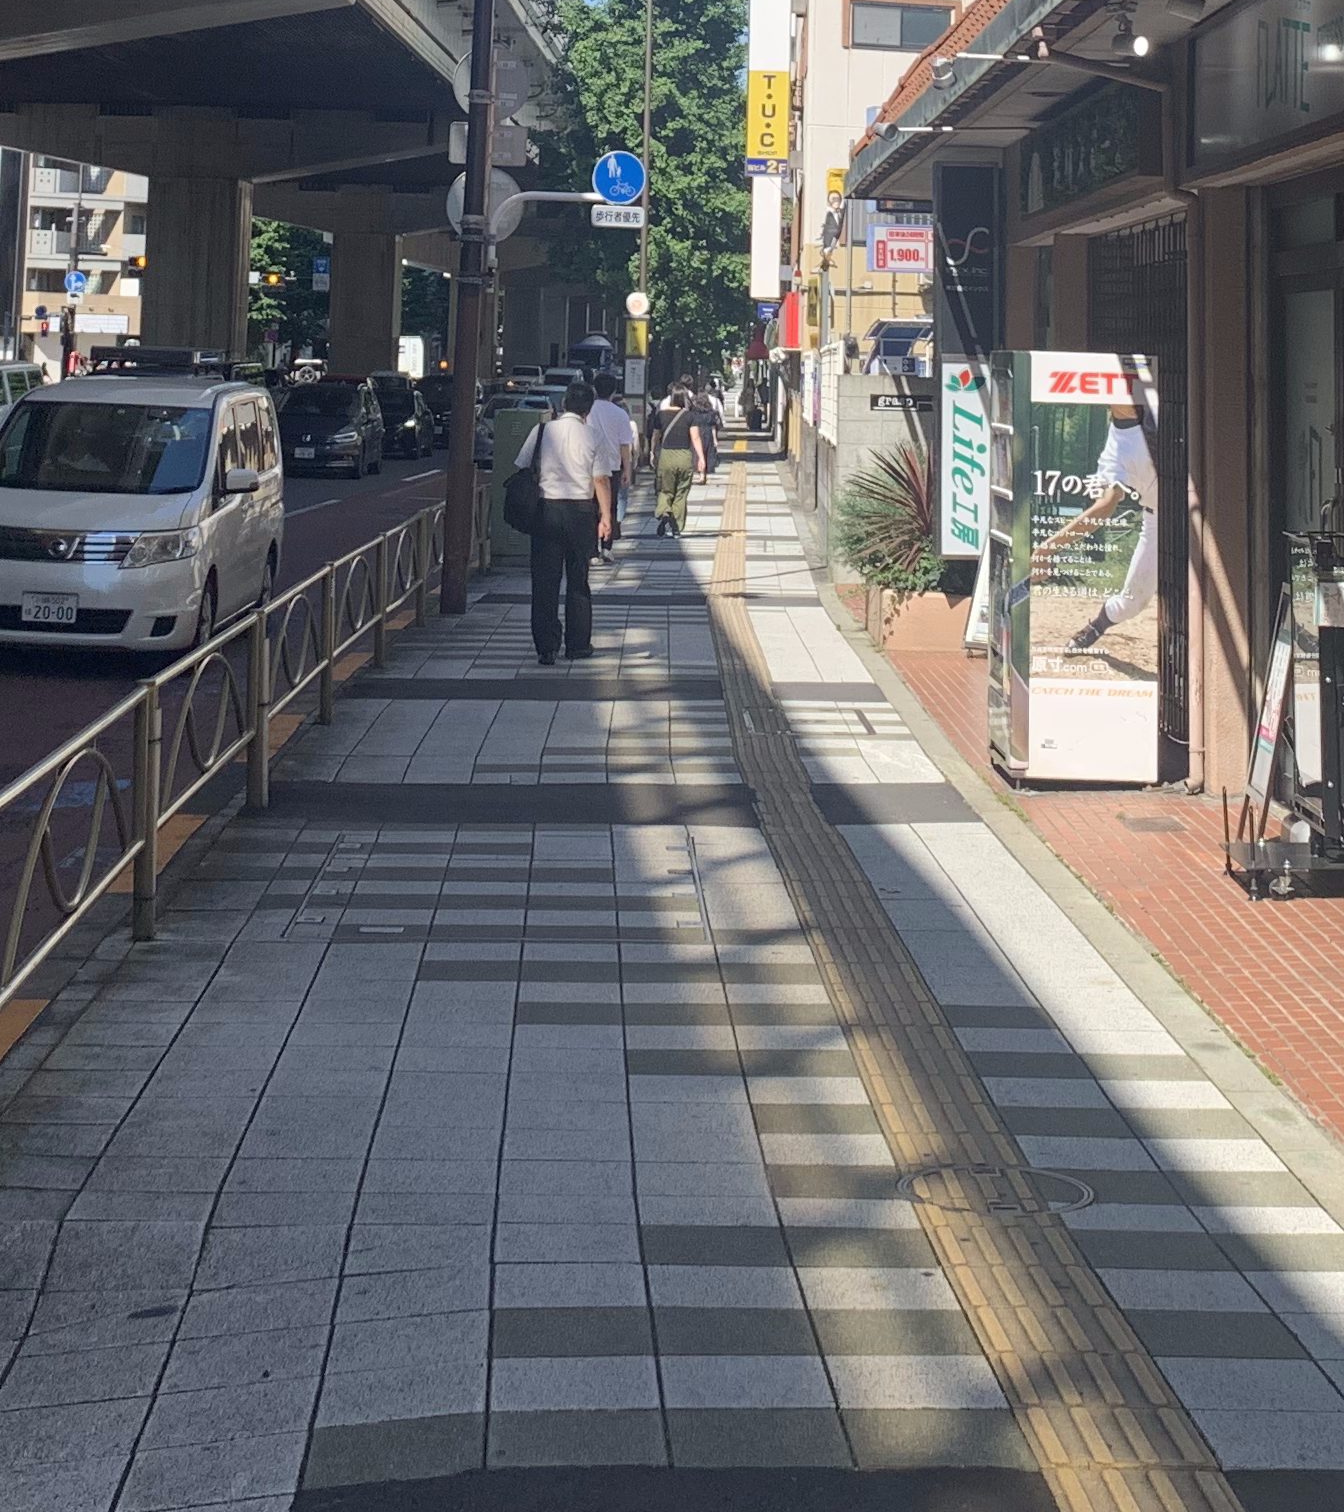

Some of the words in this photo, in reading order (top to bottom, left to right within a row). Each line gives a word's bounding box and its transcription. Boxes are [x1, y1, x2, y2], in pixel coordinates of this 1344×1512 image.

[766, 159, 788, 175] 2F
[595, 210, 641, 224] 歩行者優先
[1048, 371, 1139, 396] ZETT
[1033, 470, 1140, 500] 17の君へ。
[33, 605, 73, 621] 20-00
[1031, 687, 1075, 696] CATCH
[1077, 687, 1103, 697] THE
[1107, 689, 1154, 698] DREAM
